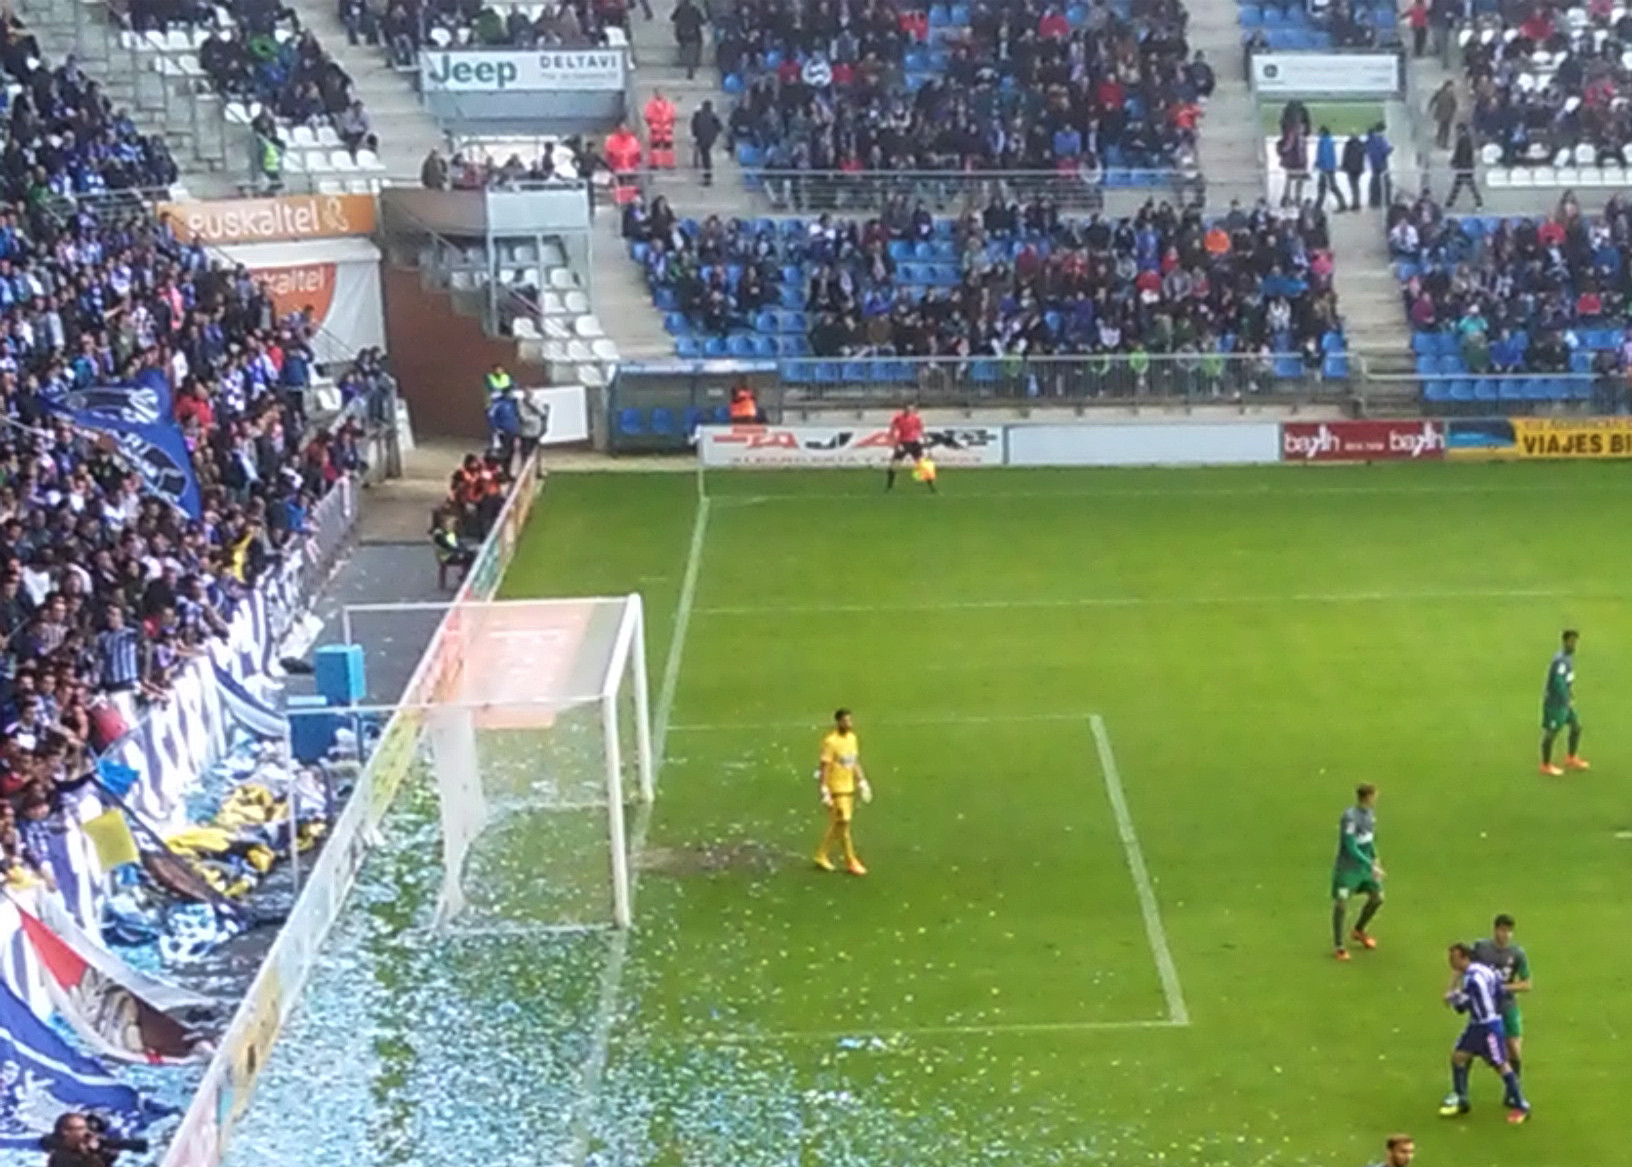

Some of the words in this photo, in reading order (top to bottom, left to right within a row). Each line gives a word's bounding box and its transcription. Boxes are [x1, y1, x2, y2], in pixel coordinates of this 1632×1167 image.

[429, 55, 517, 87] Jeep
[540, 55, 616, 69] DELTAVI
[187, 200, 320, 238] euskaltel
[1523, 433, 1603, 454] VIAJES
